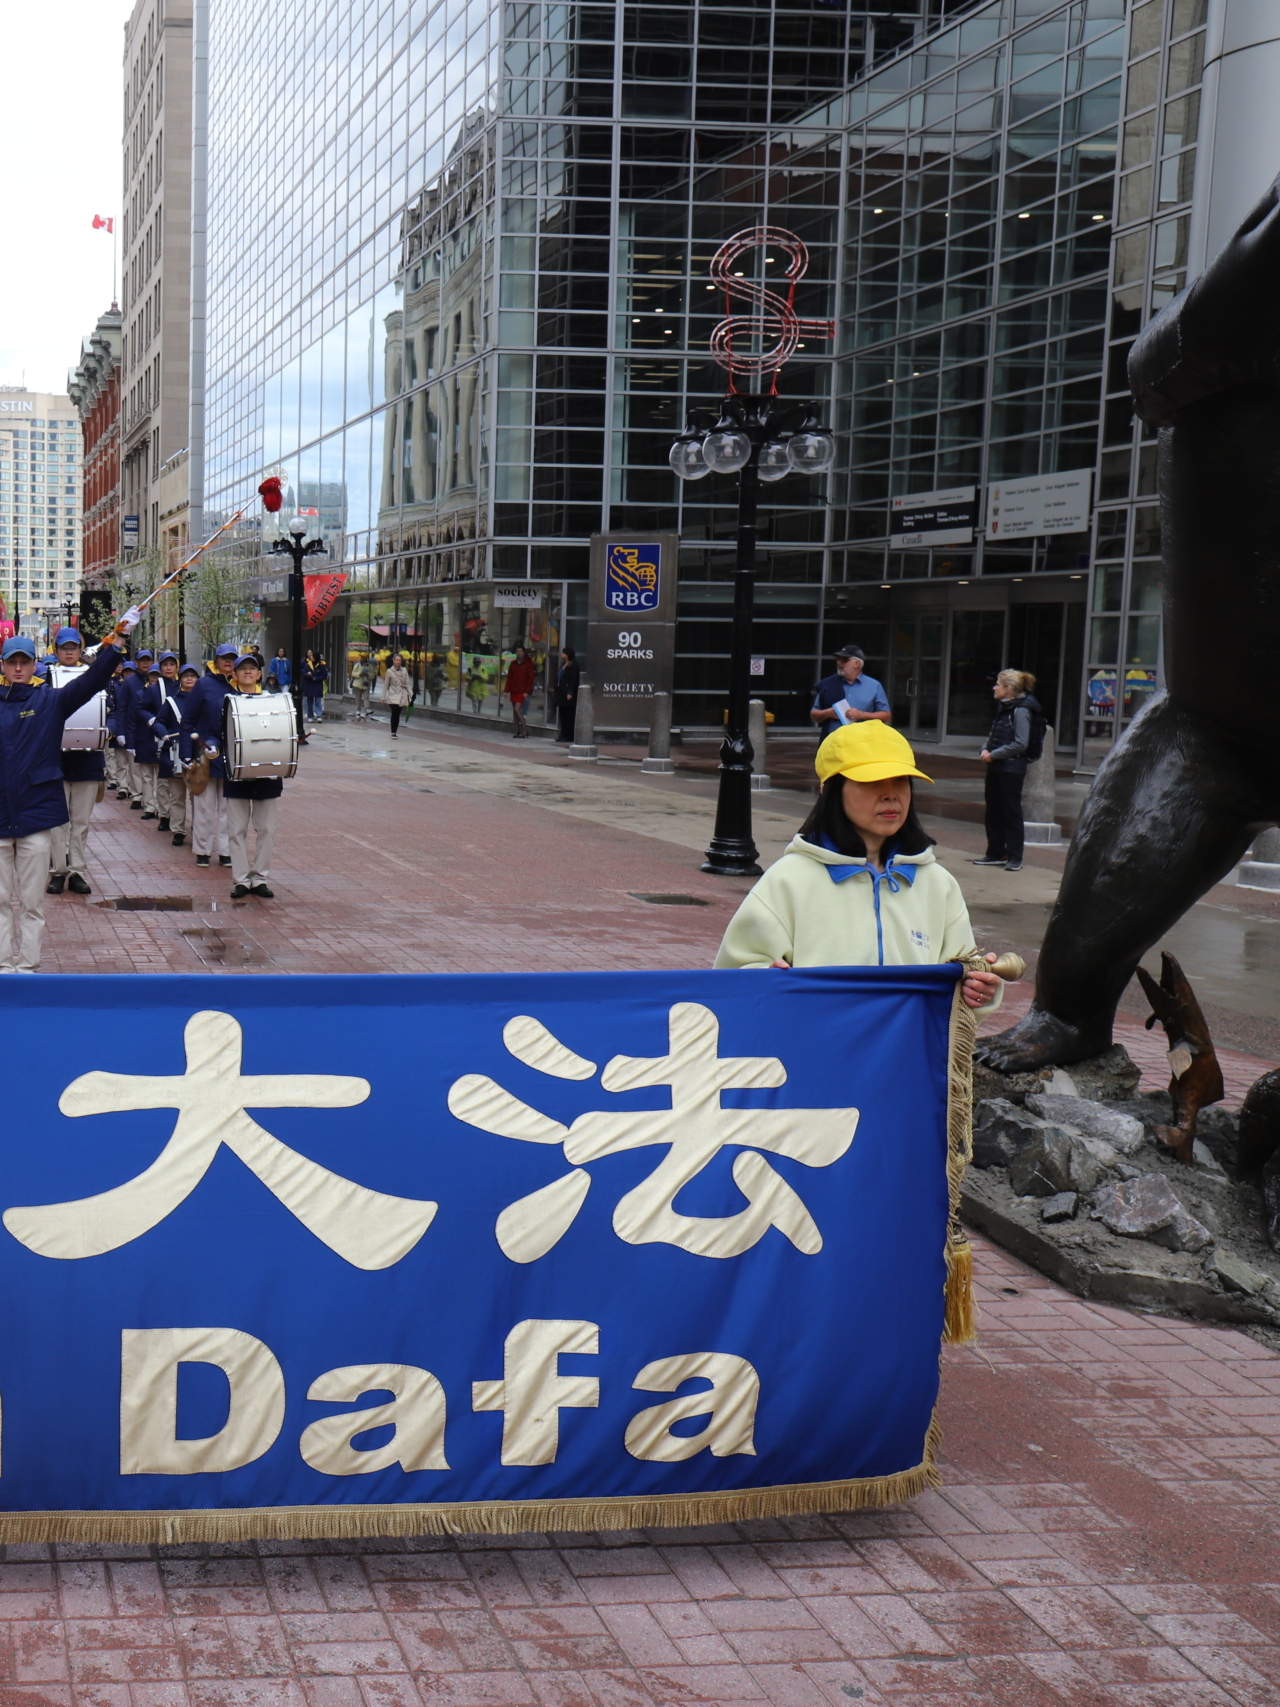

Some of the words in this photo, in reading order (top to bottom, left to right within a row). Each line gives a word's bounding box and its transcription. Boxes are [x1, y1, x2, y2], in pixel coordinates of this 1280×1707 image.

[902, 535, 922, 545] Canada
[310, 576, 342, 624] RIBFEST
[497, 586, 539, 600] society
[611, 592, 653, 606] RBC
[618, 632, 642, 648] 90
[607, 649, 654, 659] SPARKS
[603, 683, 654, 692] SOCIETY
[120, 1319, 762, 1476] Dafa
